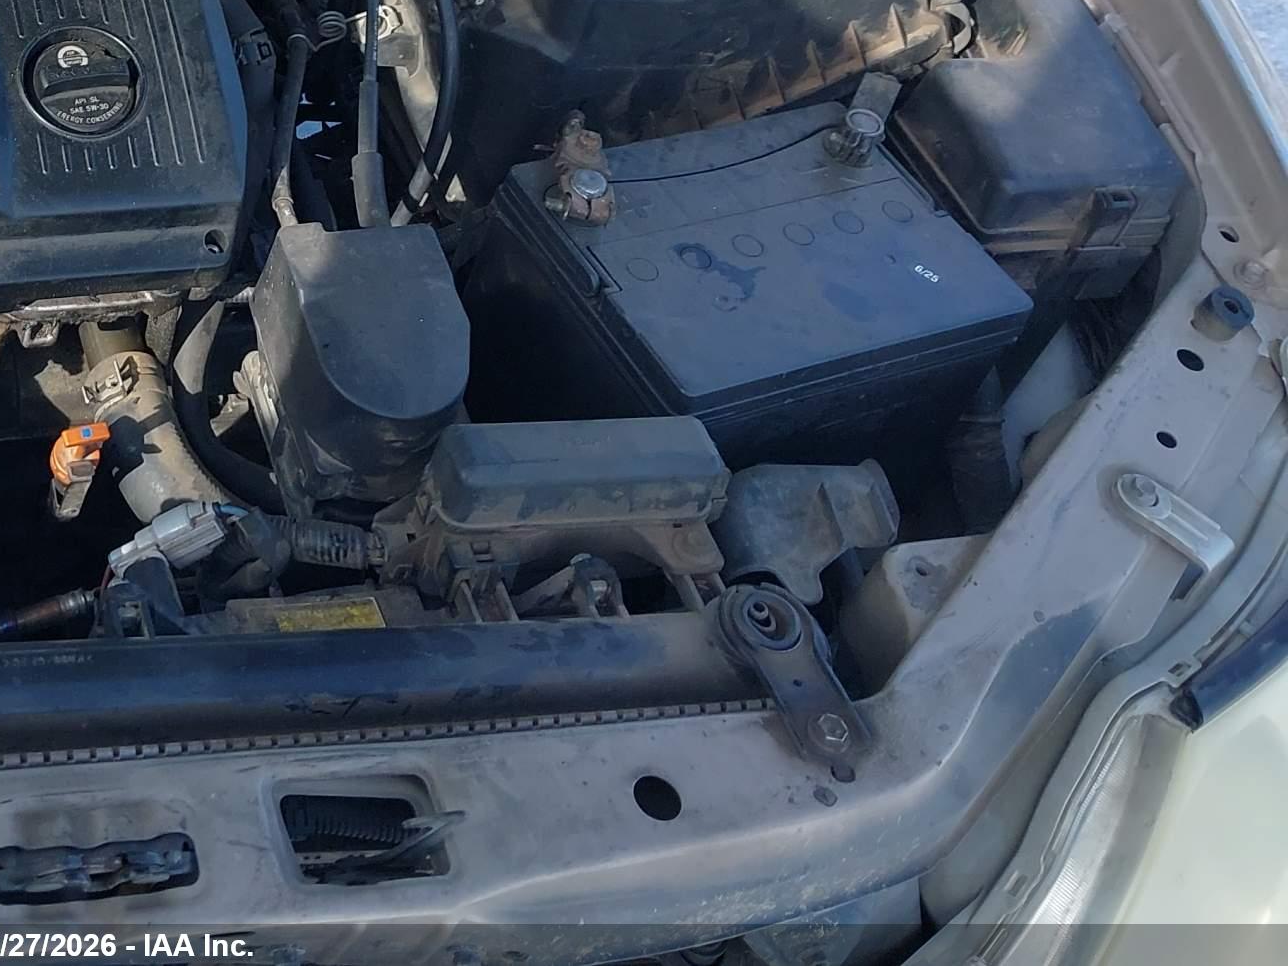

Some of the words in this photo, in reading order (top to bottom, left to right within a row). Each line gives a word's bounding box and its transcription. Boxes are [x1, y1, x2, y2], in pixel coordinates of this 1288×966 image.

[57, 111, 83, 124] ENERGY
[86, 102, 123, 124] CONSERVING
[70, 106, 84, 114] SAE
[86, 103, 109, 112] 5W-30
[915, 265, 939, 282] 6/25
